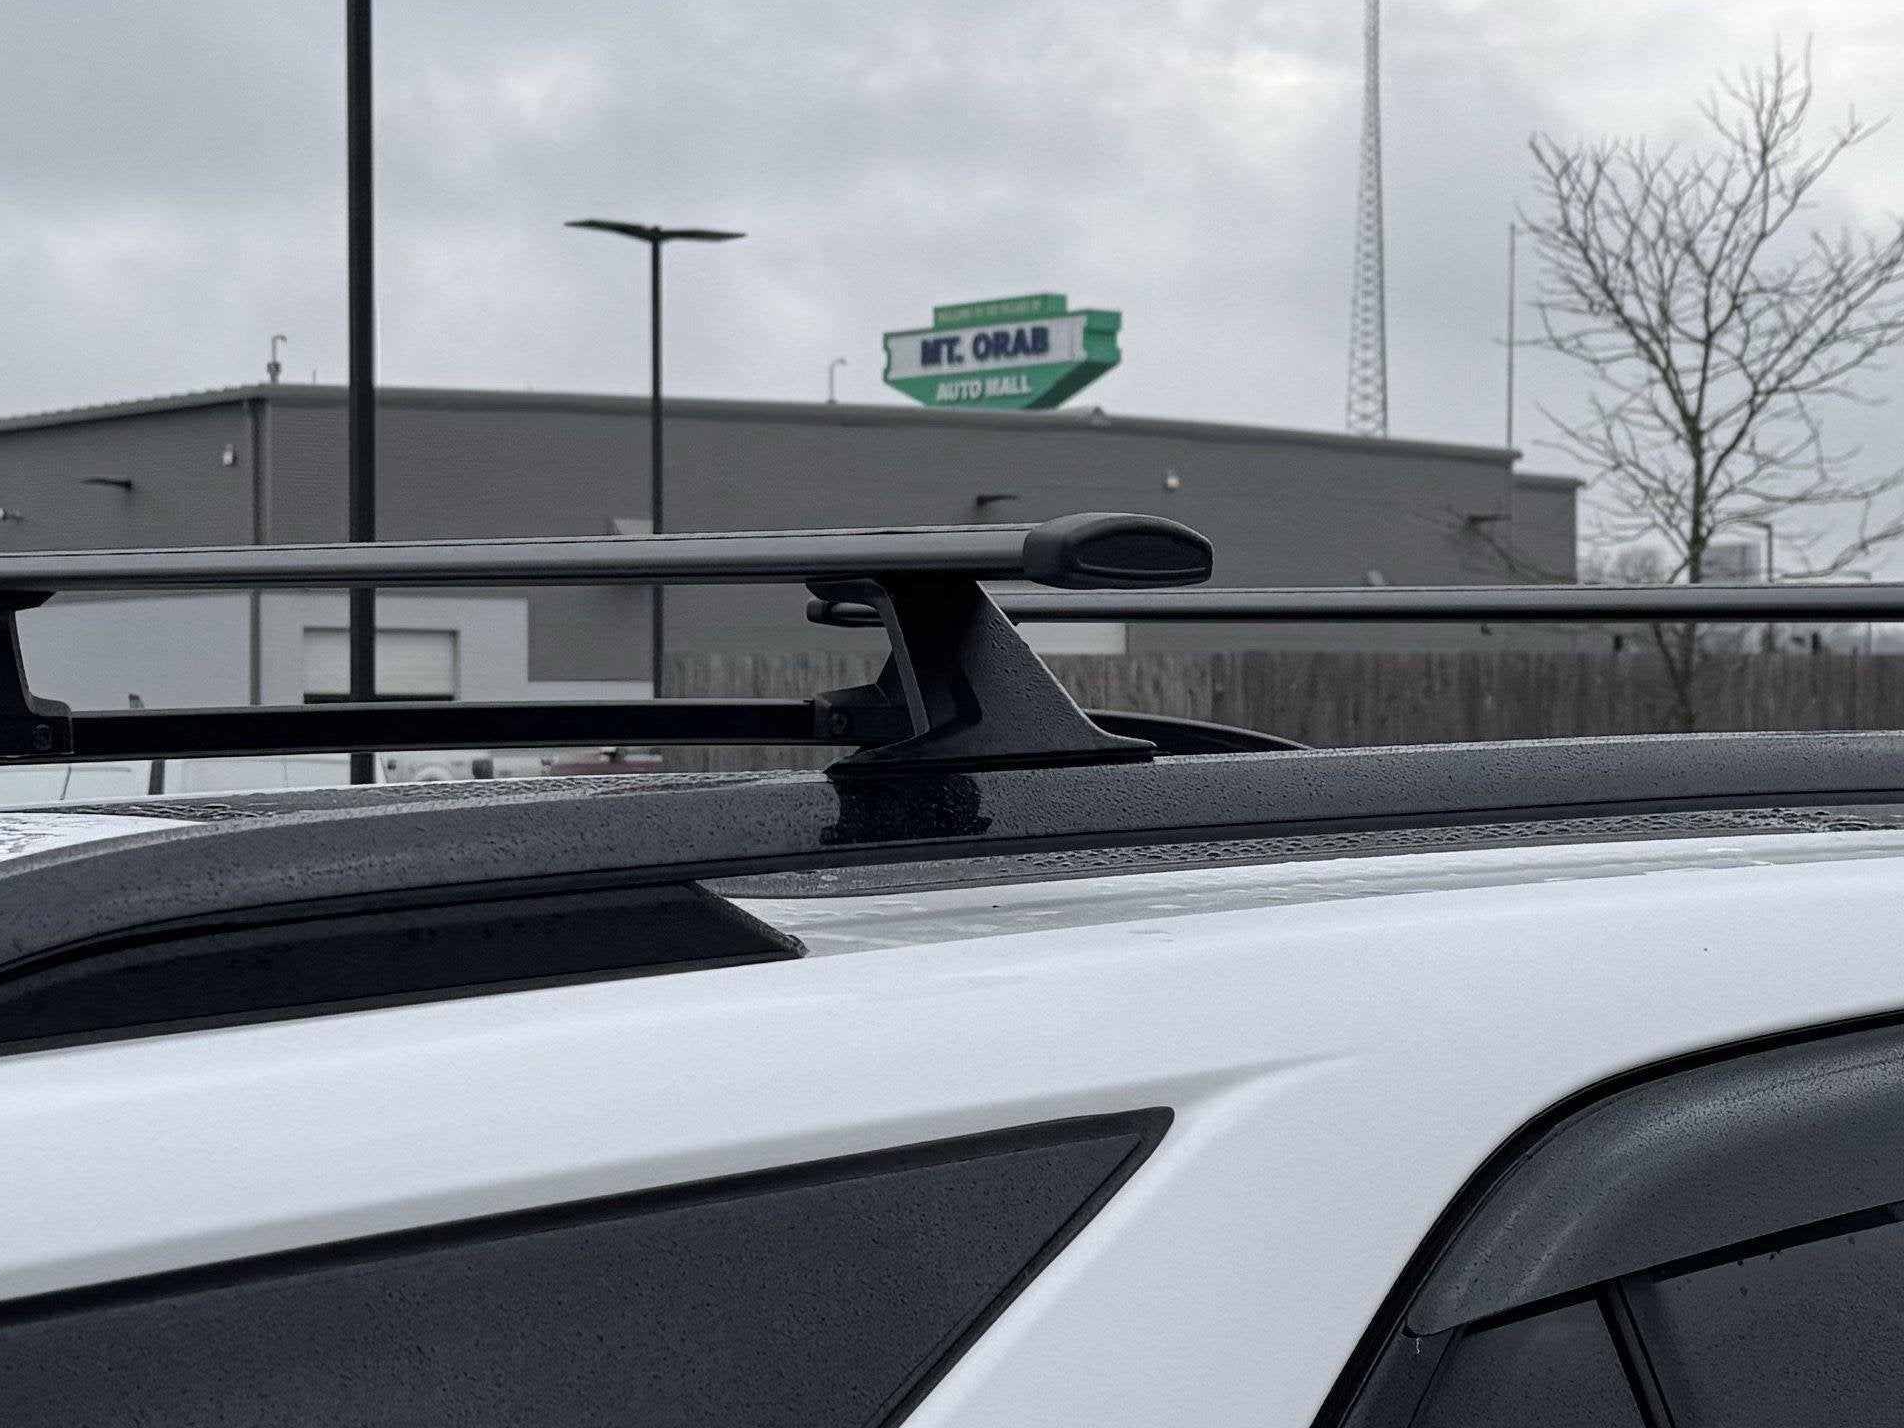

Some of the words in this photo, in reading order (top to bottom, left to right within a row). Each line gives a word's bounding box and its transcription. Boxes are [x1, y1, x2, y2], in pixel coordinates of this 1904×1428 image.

[920, 336, 964, 368] MT.
[972, 326, 1050, 361] ORAB
[936, 379, 982, 401] AUTO
